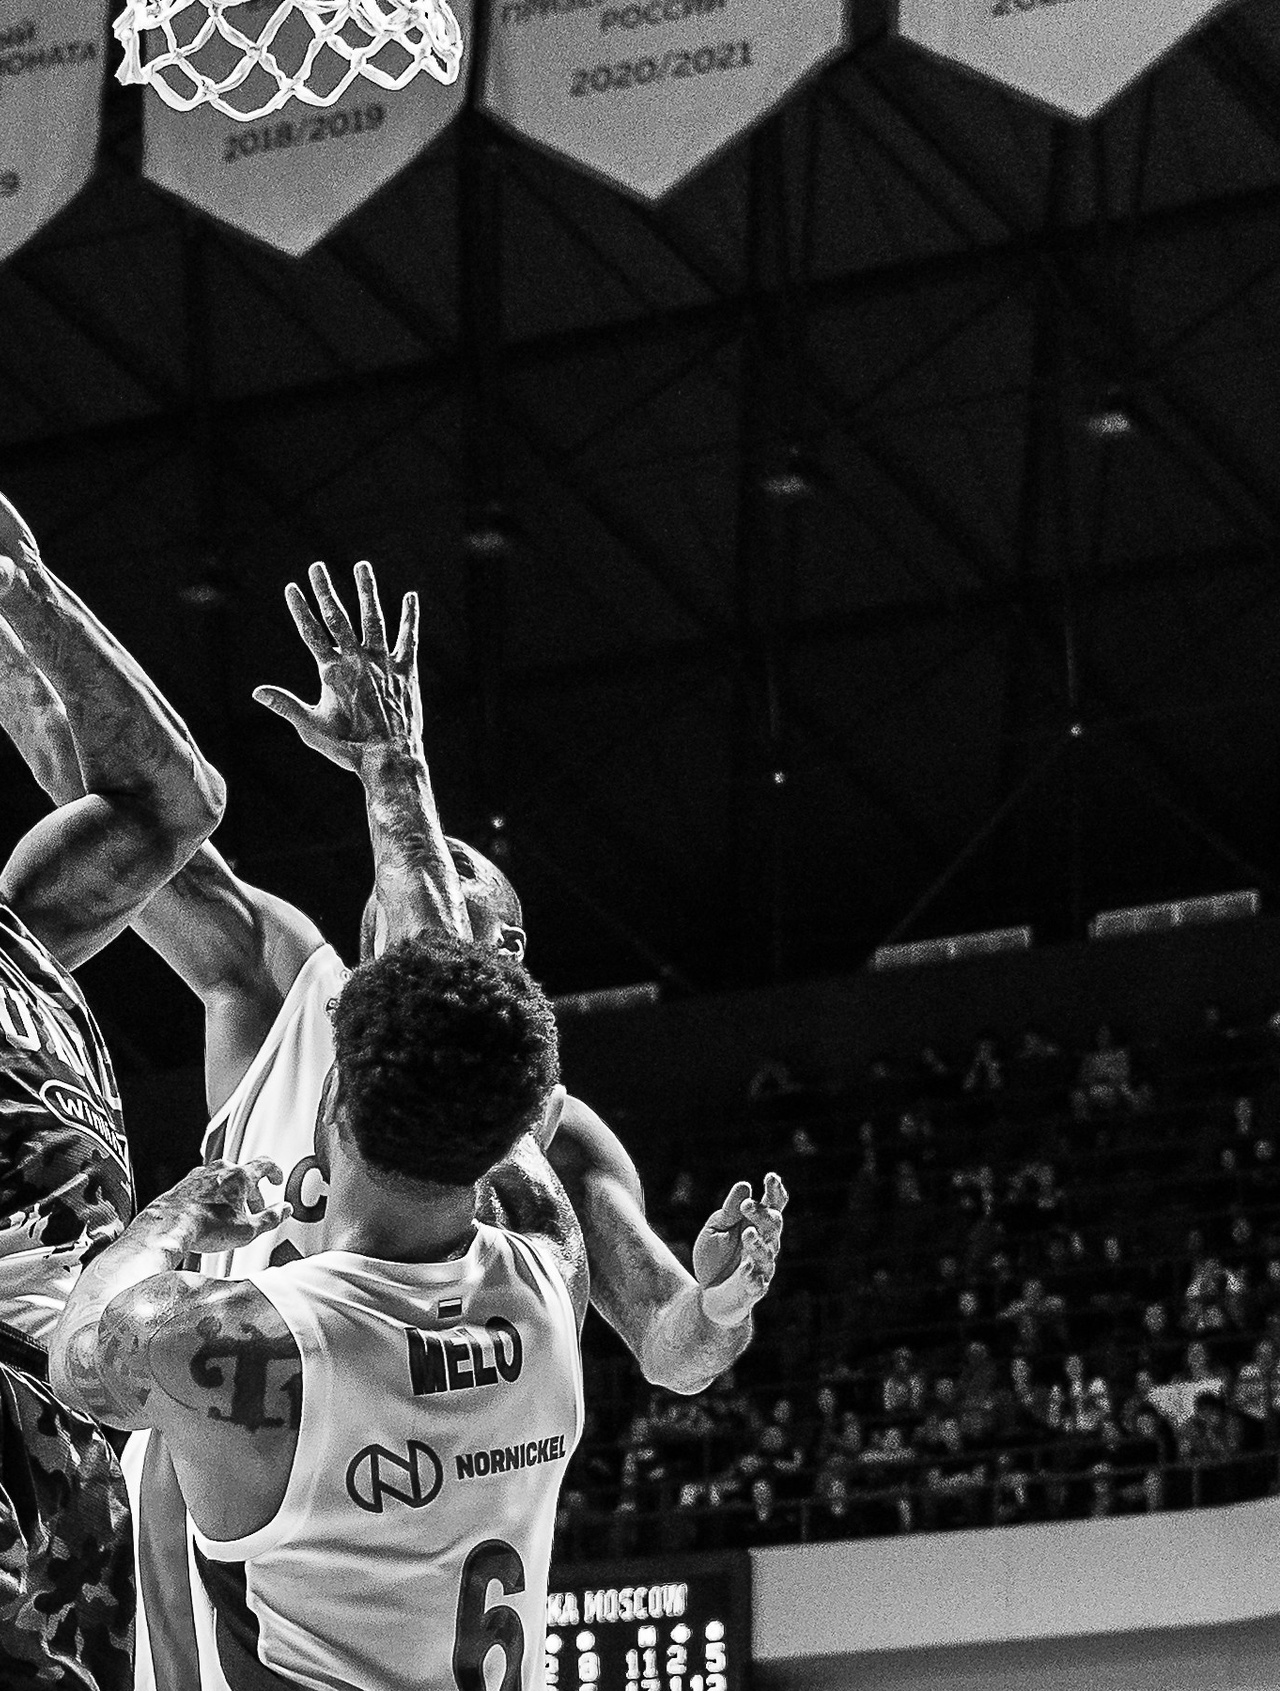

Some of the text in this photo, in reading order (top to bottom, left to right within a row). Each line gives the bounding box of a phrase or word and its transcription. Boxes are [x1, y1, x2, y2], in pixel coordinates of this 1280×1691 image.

[570, 41, 754, 97] 2020/2021
[223, 102, 386, 164] 2018/2019
[405, 1316, 524, 1396] MELO
[456, 1434, 567, 1480] NORNICKEL
[583, 1582, 688, 1624] MOSCOW
